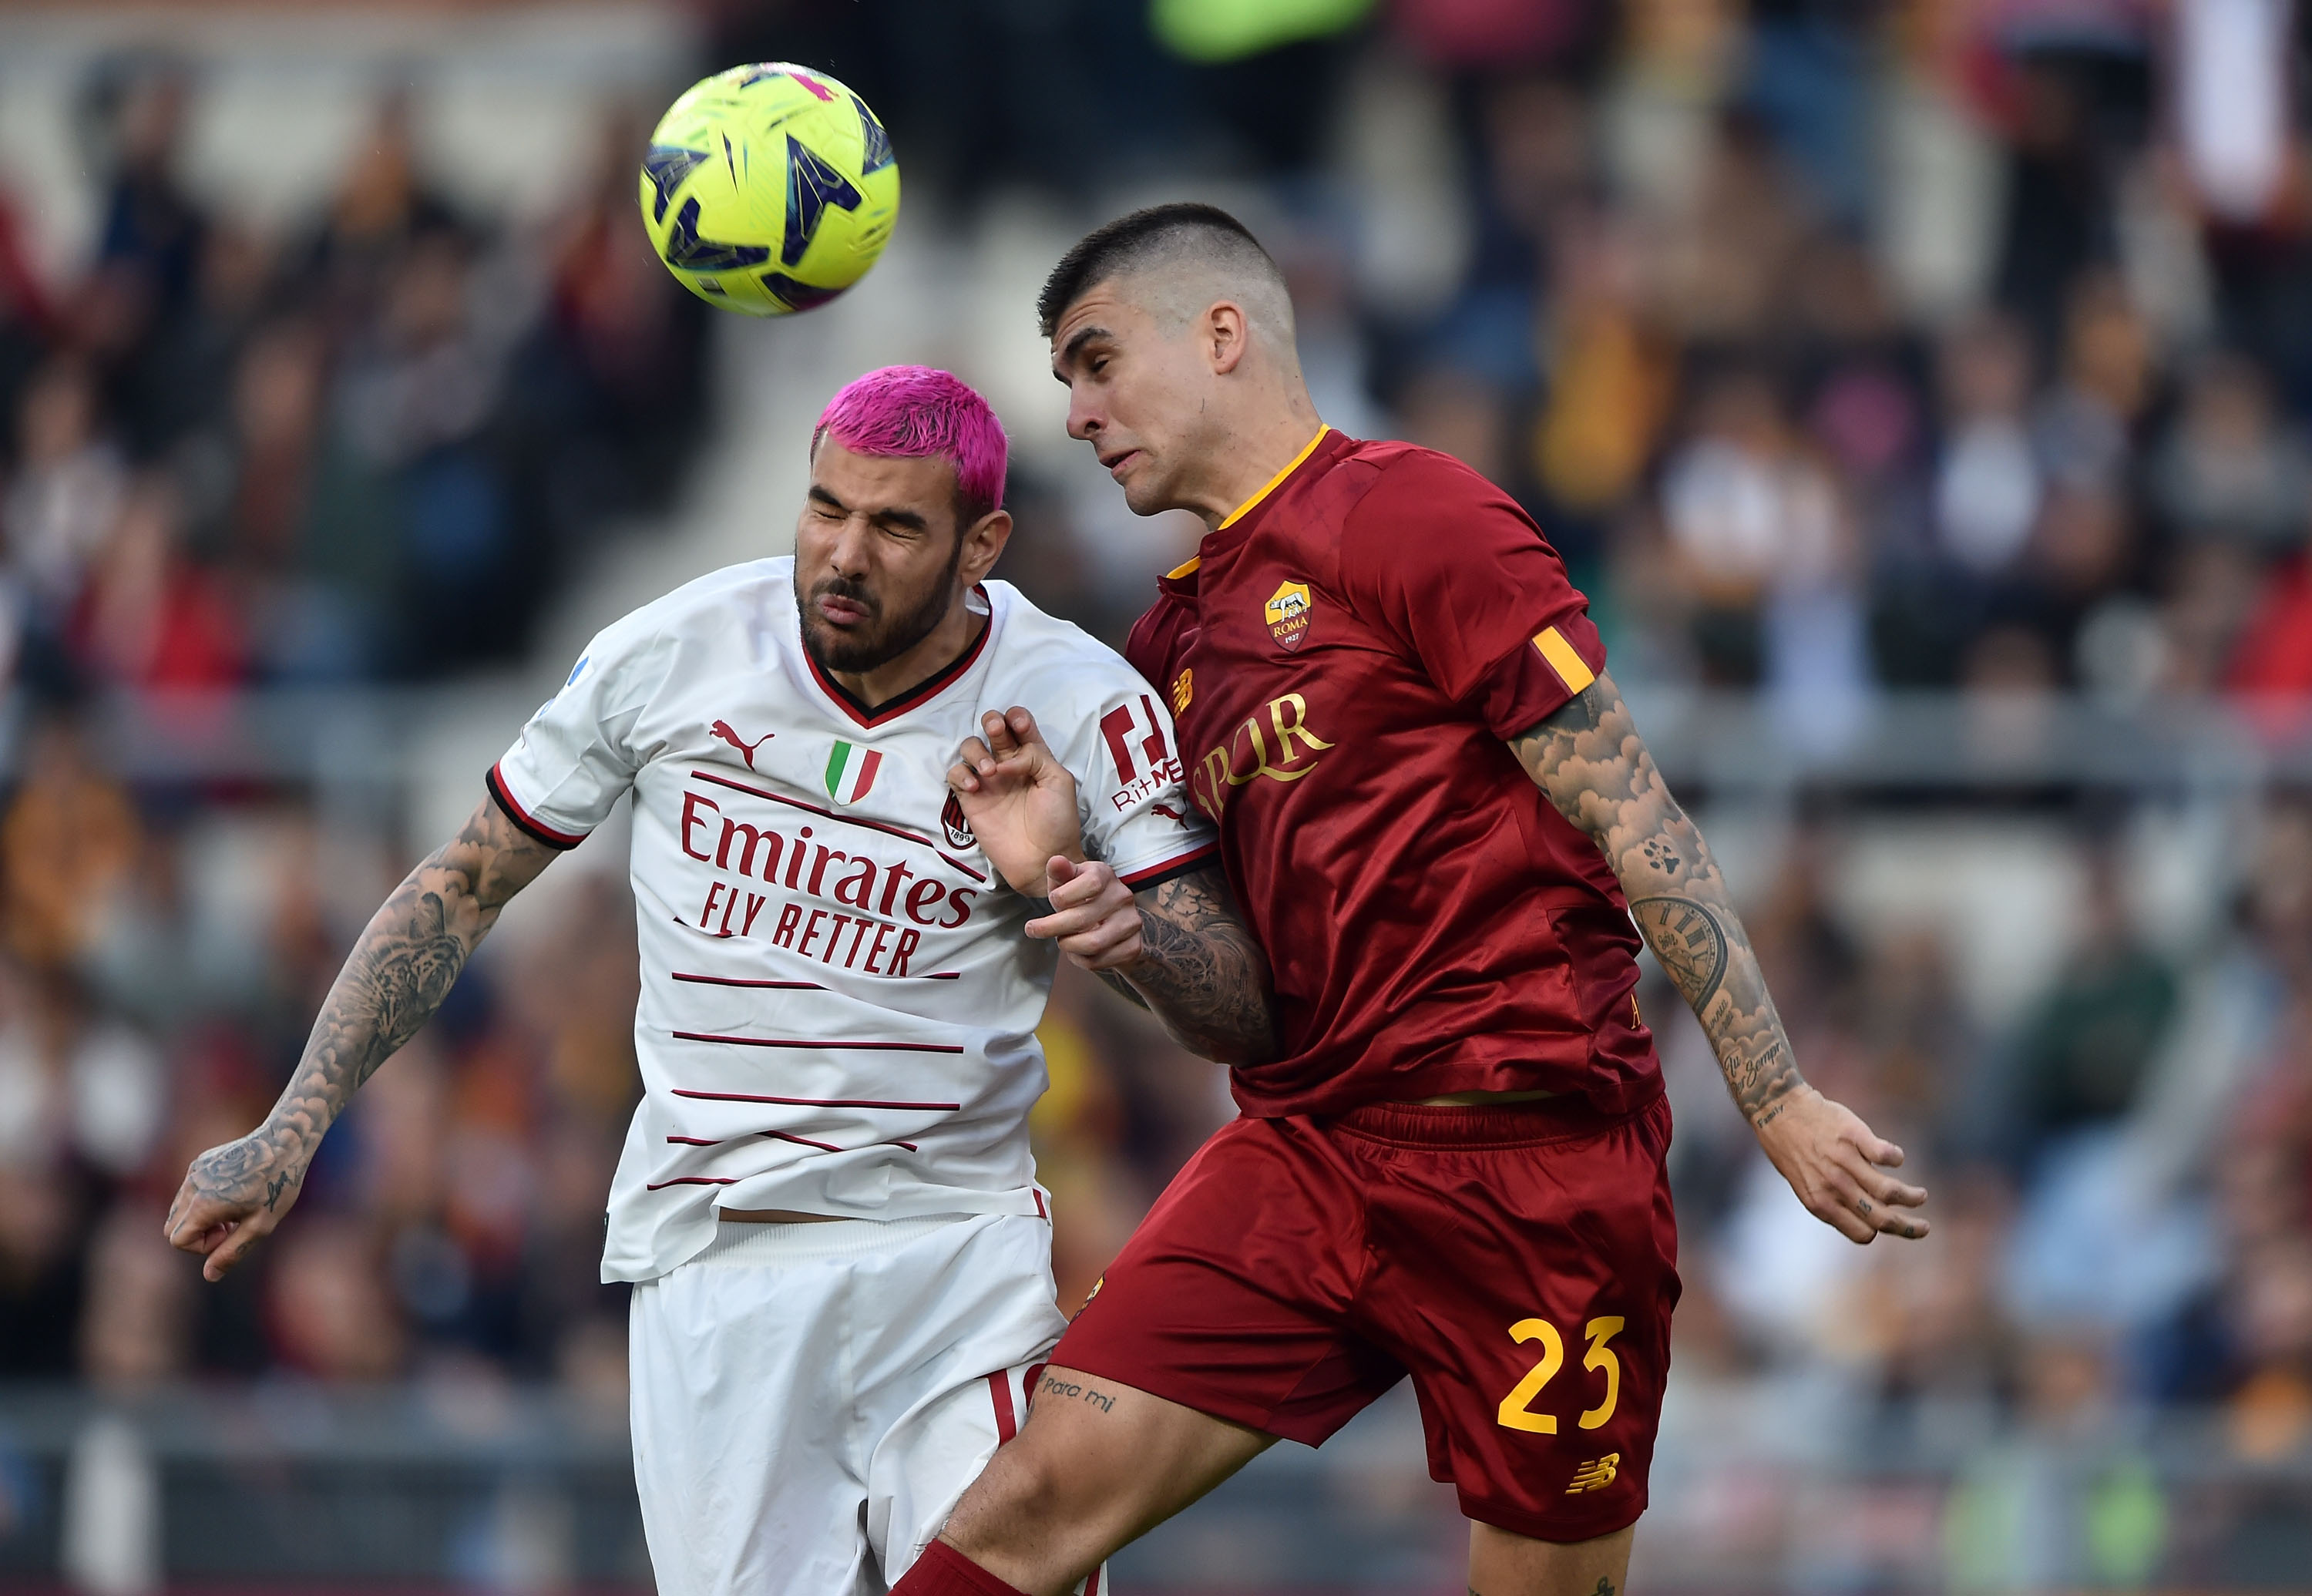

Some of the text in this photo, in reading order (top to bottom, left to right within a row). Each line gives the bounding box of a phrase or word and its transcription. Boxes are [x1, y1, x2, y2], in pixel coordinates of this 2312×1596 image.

[1273, 616, 1309, 637] ROMA
[1285, 633, 1299, 644] 1927
[950, 828, 971, 842] 1899
[681, 791, 978, 929] Emirates
[700, 881, 767, 938] FLY
[1746, 1040, 1782, 1088] Sempr
[1497, 1315, 1625, 1435] 23
[1084, 1389, 1117, 1413] mi
